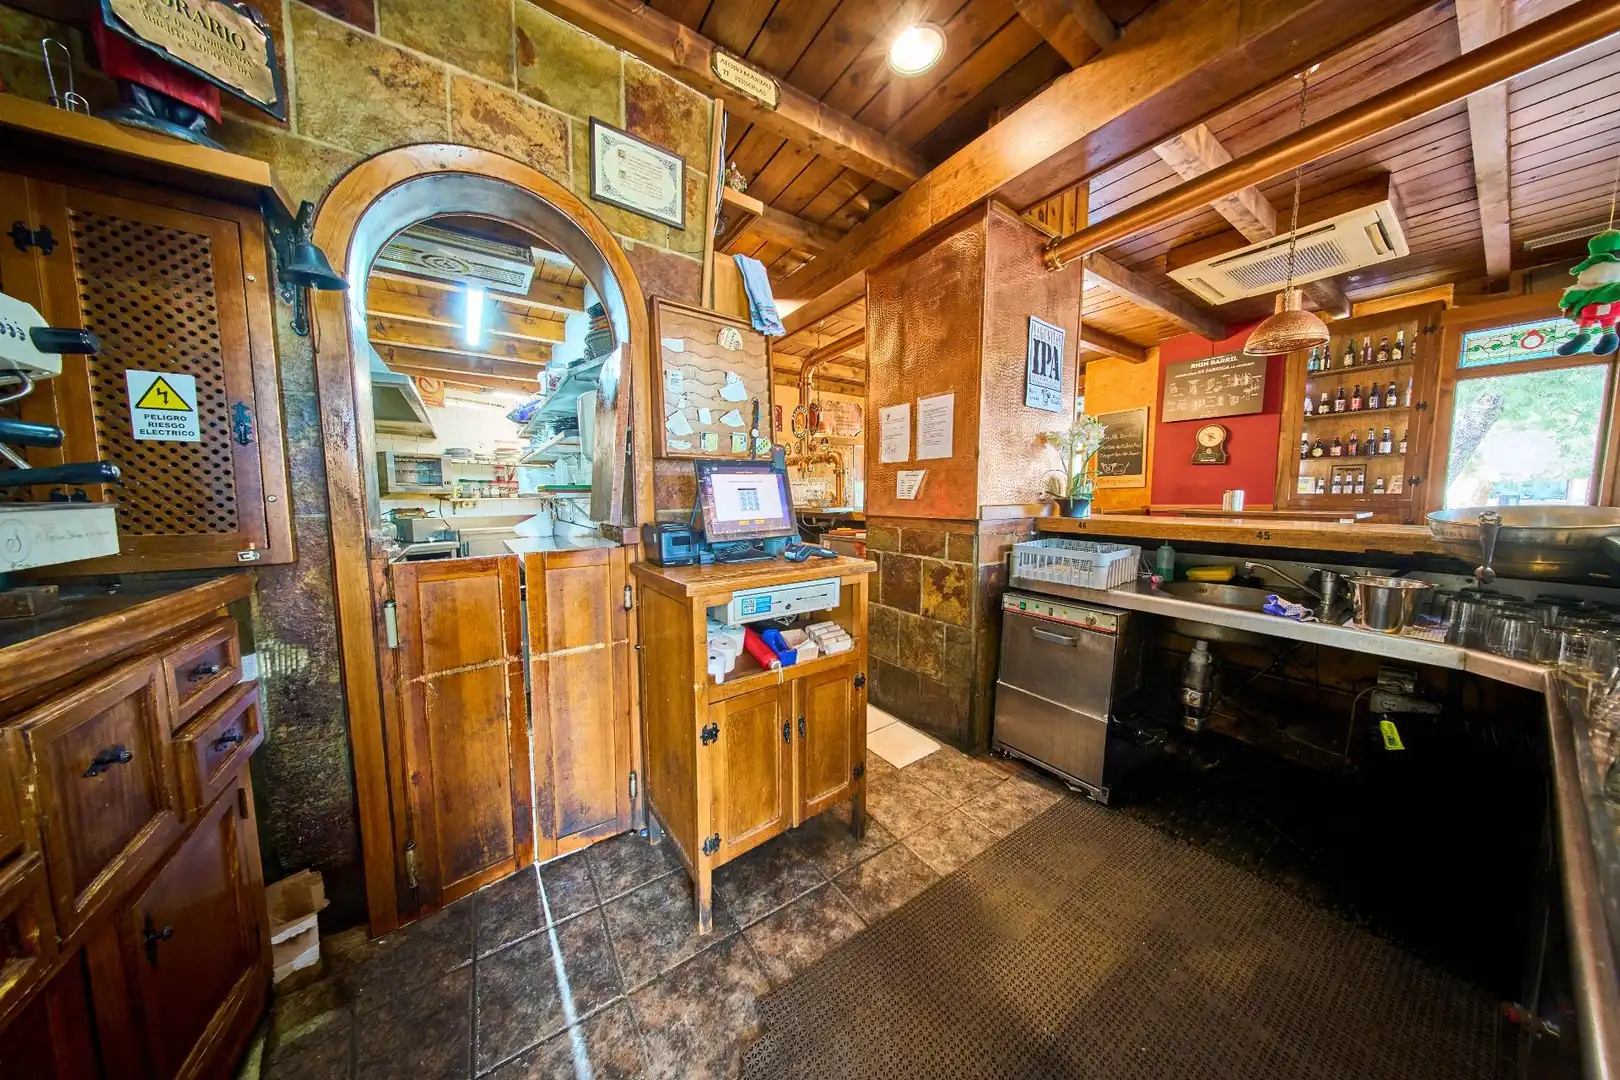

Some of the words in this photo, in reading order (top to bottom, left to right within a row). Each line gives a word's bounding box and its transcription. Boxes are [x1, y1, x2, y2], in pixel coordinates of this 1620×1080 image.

[1031, 338, 1060, 381] IPA
[1210, 355, 1239, 366] BARREL
[140, 429, 195, 437] ELECTRICO
[1078, 521, 1087, 530] 46
[1256, 530, 1271, 540] 45
